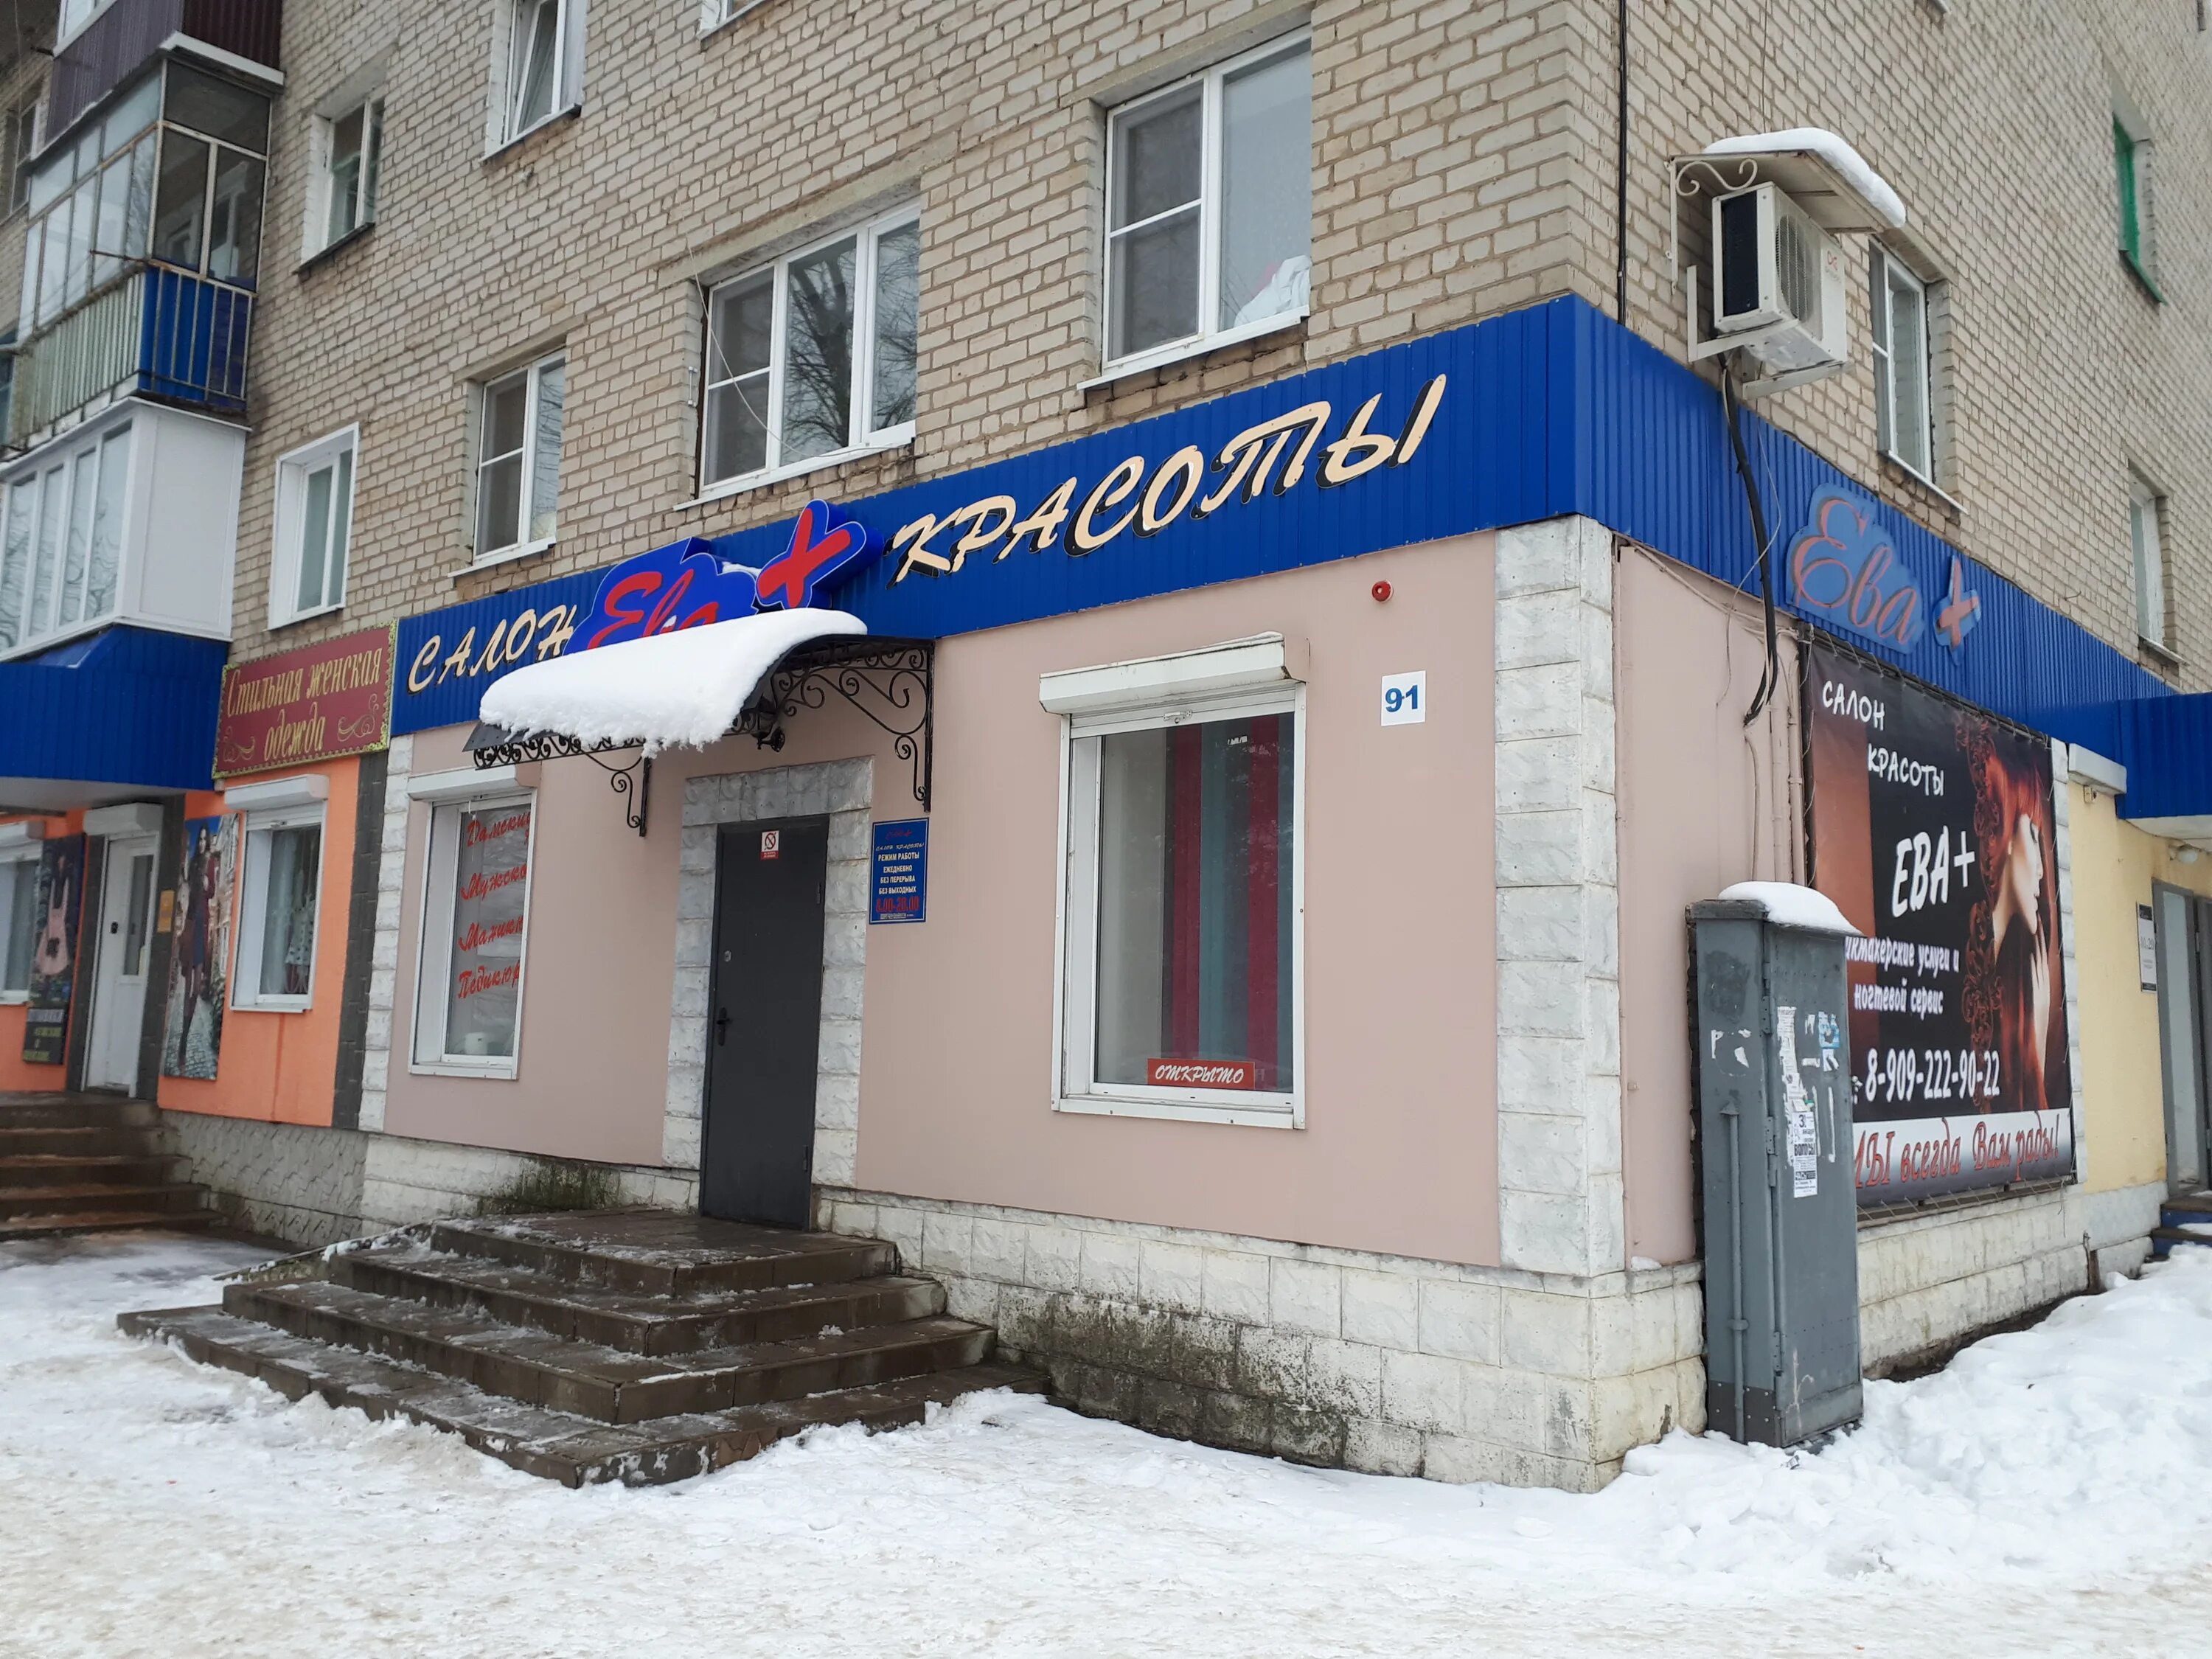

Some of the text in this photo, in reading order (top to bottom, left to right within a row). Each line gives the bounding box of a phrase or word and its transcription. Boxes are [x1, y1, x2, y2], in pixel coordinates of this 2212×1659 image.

[407, 603, 577, 694] САЛОН
[886, 372, 1447, 588] КРАСОТЫ
[226, 647, 383, 718] Стильная женская
[1385, 684, 1418, 713] 91
[1822, 680, 1885, 731] САЛОН
[263, 701, 327, 762] одежда
[1867, 742, 1945, 797] КРАСОТЫ
[467, 811, 530, 847] Дамски
[877, 852, 919, 861] РЕЖИМ РАБОТЫ
[883, 864, 913, 874] ЕЖЕДНЕВНО
[459, 863, 527, 901] Мужско
[878, 886, 917, 895] БЕЗ ВЫХОДНЫХ
[889, 874, 916, 883] ПЕРЕРЫВА
[457, 914, 524, 951] Маникю
[1845, 936, 1960, 979] икмахерские услуги и
[1854, 977, 1944, 1021] ногтевой сервис
[1864, 1047, 2001, 1102] 8-909-222-90-22
[1899, 1116, 1962, 1183] всегда
[1972, 1120, 2011, 1171] Вам
[2015, 1110, 2060, 1182] рады!
